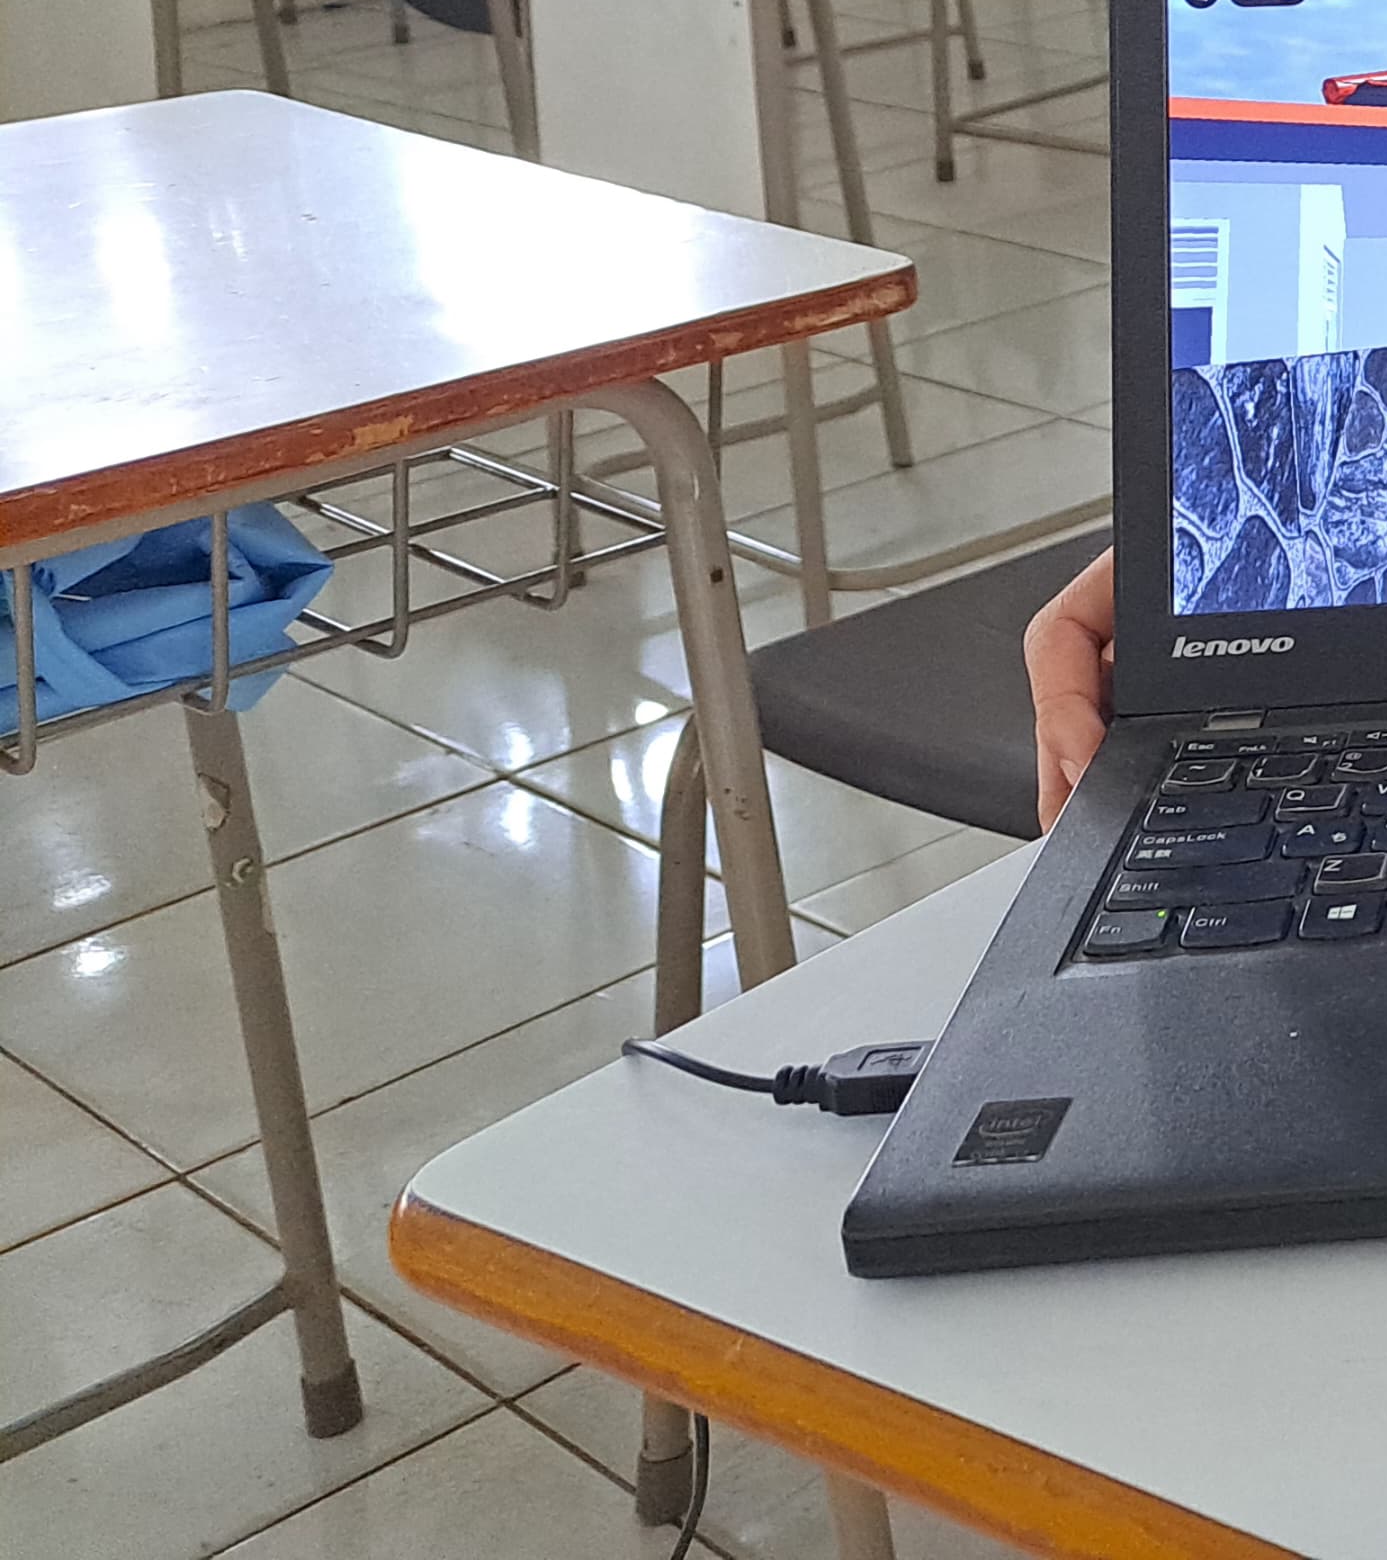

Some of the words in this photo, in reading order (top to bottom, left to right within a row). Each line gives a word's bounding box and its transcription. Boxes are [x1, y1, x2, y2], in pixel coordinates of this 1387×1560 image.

[1171, 636, 1296, 659] lenovo
[1286, 789, 1306, 801] Q
[1157, 805, 1187, 814] Tab
[1296, 823, 1316, 836] A
[1323, 859, 1344, 872] Z
[1117, 881, 1160, 893] Shift
[1194, 916, 1227, 928] Ctrl
[1097, 925, 1122, 935] Fn
